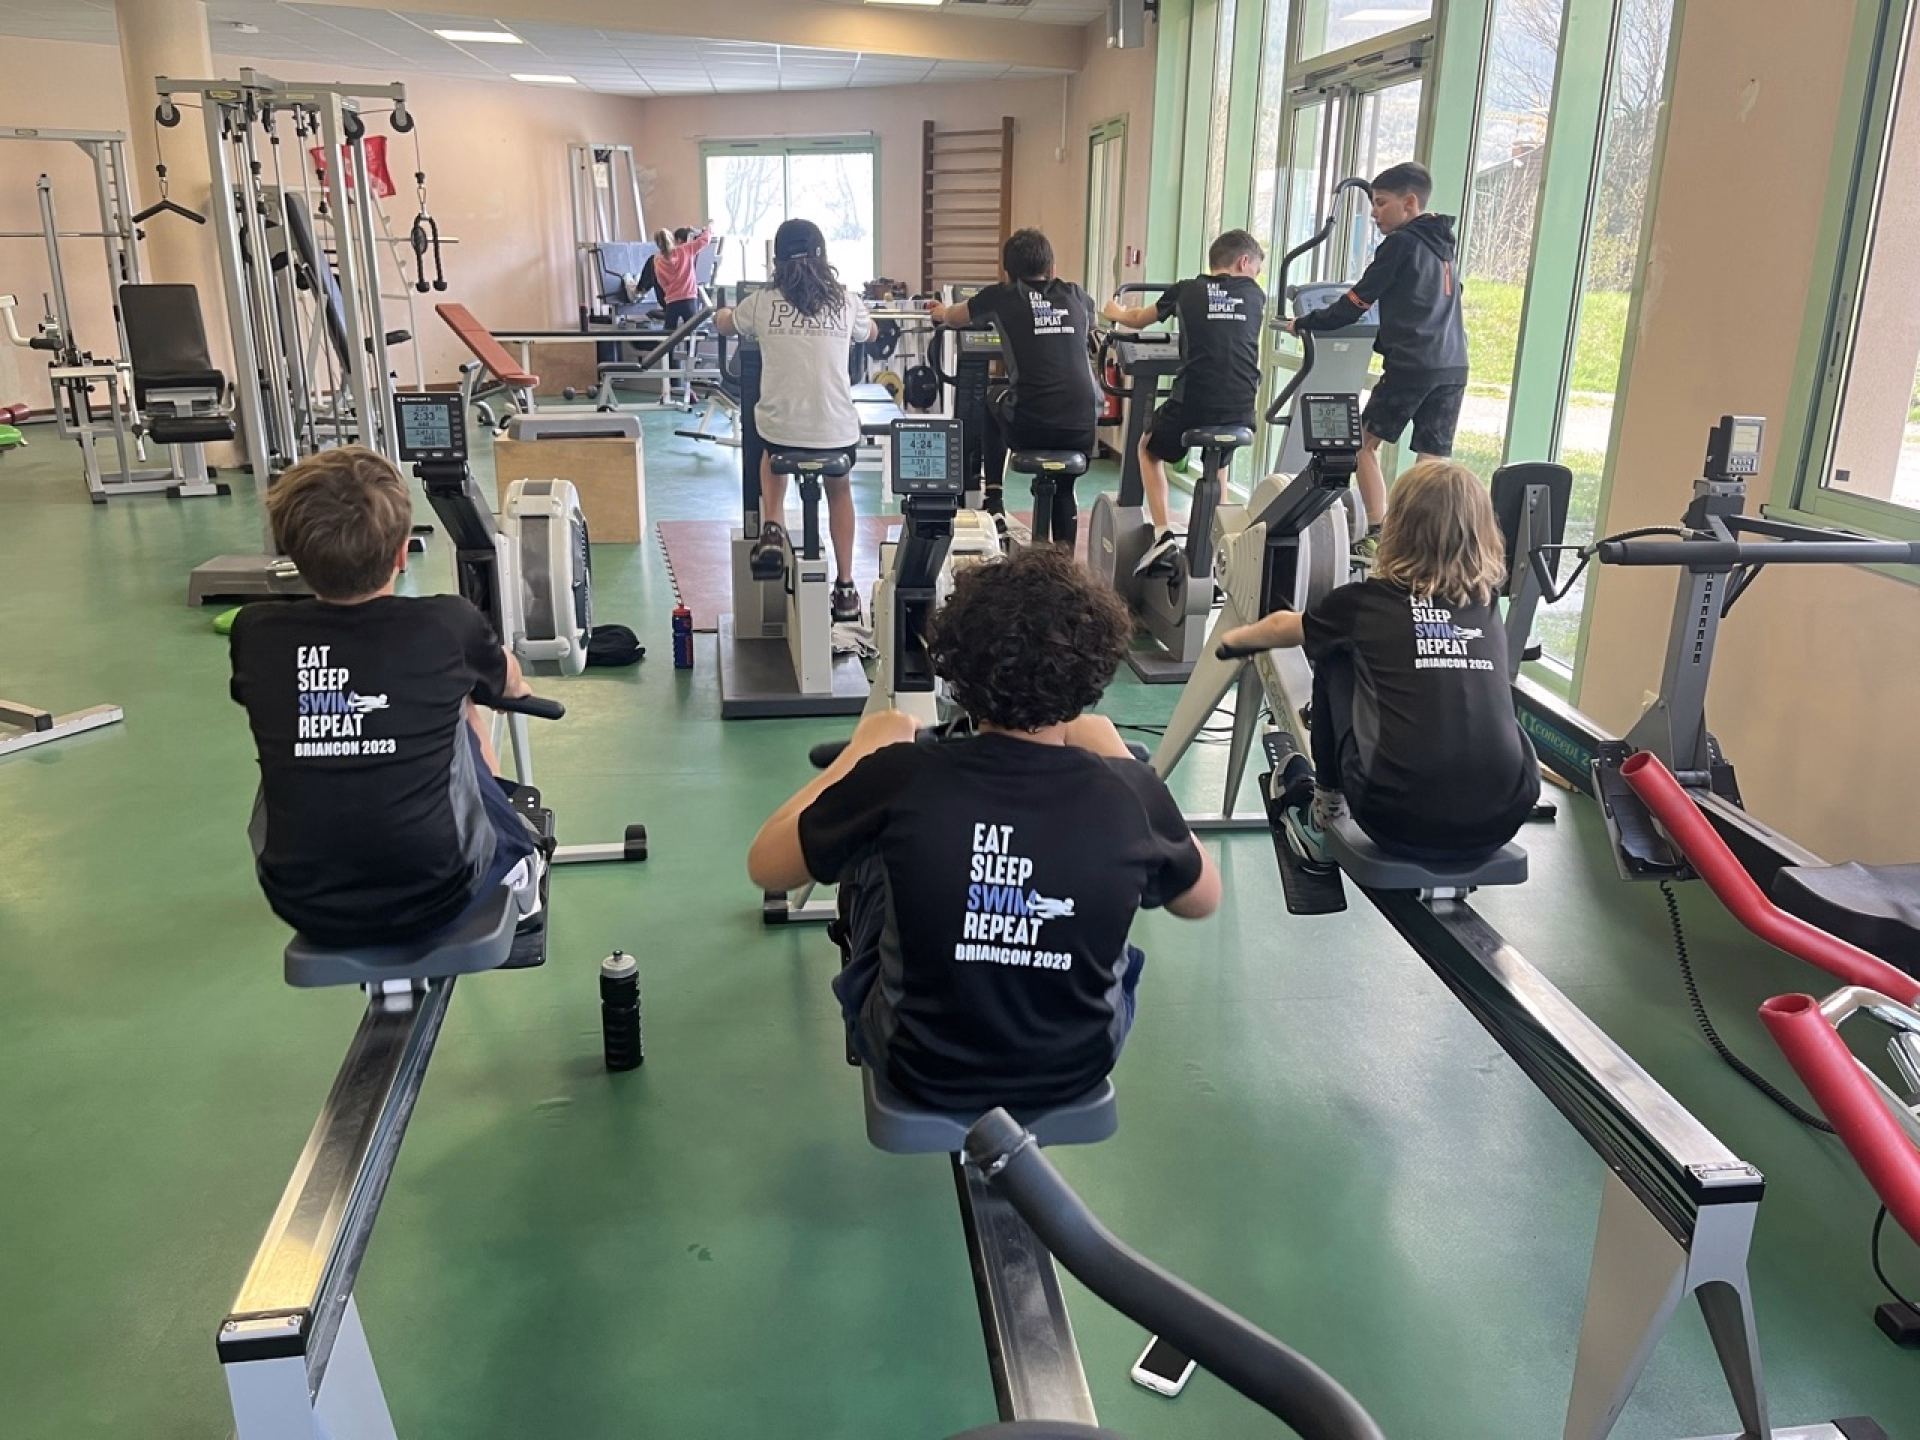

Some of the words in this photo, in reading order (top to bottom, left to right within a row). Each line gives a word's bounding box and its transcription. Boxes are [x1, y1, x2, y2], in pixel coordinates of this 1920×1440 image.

[413, 411, 436, 421] 2:33
[910, 440, 932, 449] 4:24
[1412, 608, 1452, 623] SLEEP
[1415, 623, 1460, 639] SWIM
[297, 645, 331, 668] EAT
[1416, 638, 1468, 656] REPEAT
[1415, 657, 1468, 669] BRIANCON
[1468, 658, 1494, 671] 2023
[298, 668, 349, 691] SLEEP
[299, 691, 356, 714] SWIM
[299, 713, 364, 738] REPEAT
[294, 740, 360, 757] BRIANCON
[361, 738, 397, 754] 2023
[972, 822, 1014, 855] EAT
[969, 852, 1033, 887] SLEEP
[966, 882, 1037, 917] SWIM
[963, 911, 1044, 946] REPEAT
[954, 942, 1032, 966] BRIANCON
[1032, 950, 1072, 971] 2023
